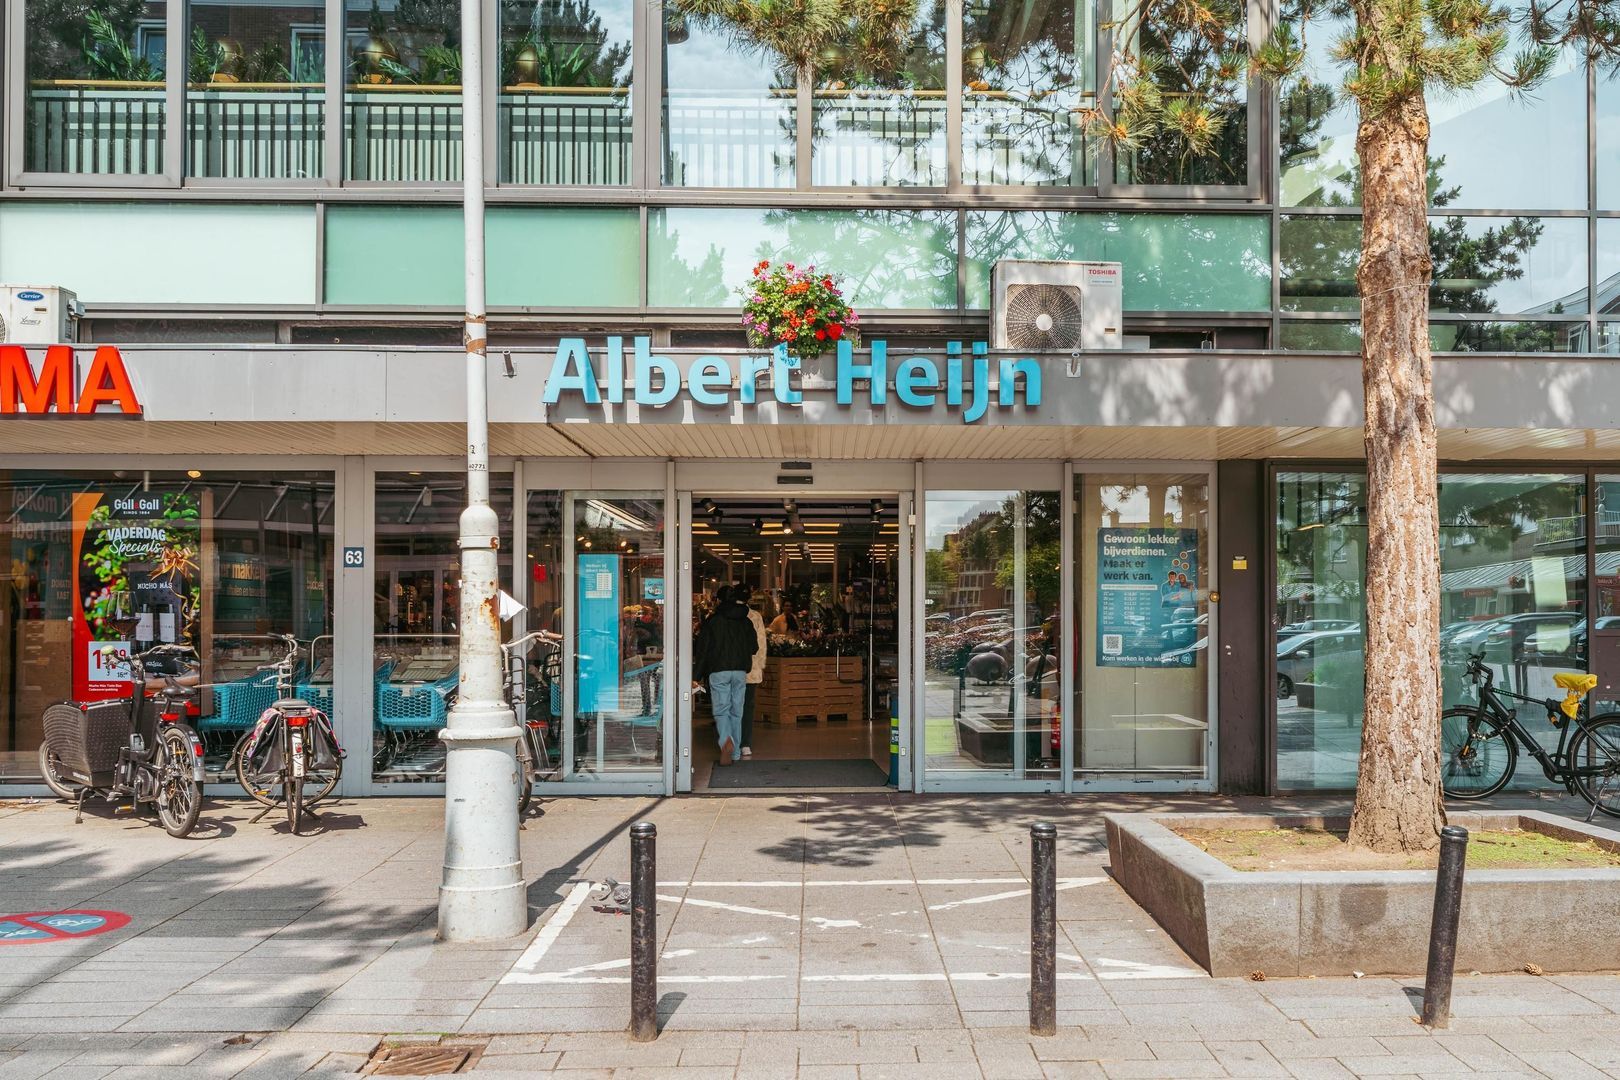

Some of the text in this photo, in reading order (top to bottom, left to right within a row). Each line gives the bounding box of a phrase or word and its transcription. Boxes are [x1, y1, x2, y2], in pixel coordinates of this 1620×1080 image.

[0, 345, 143, 415] MA
[543, 336, 1041, 423] Albert Heijn
[107, 527, 166, 541] VADERDAG
[1103, 534, 1179, 544] Gewoon lekker
[108, 539, 165, 556] Specials
[1103, 546, 1168, 557] bijverdienen.
[345, 551, 363, 564] 63
[1103, 560, 1131, 568] Maak
[1103, 571, 1129, 580] werk
